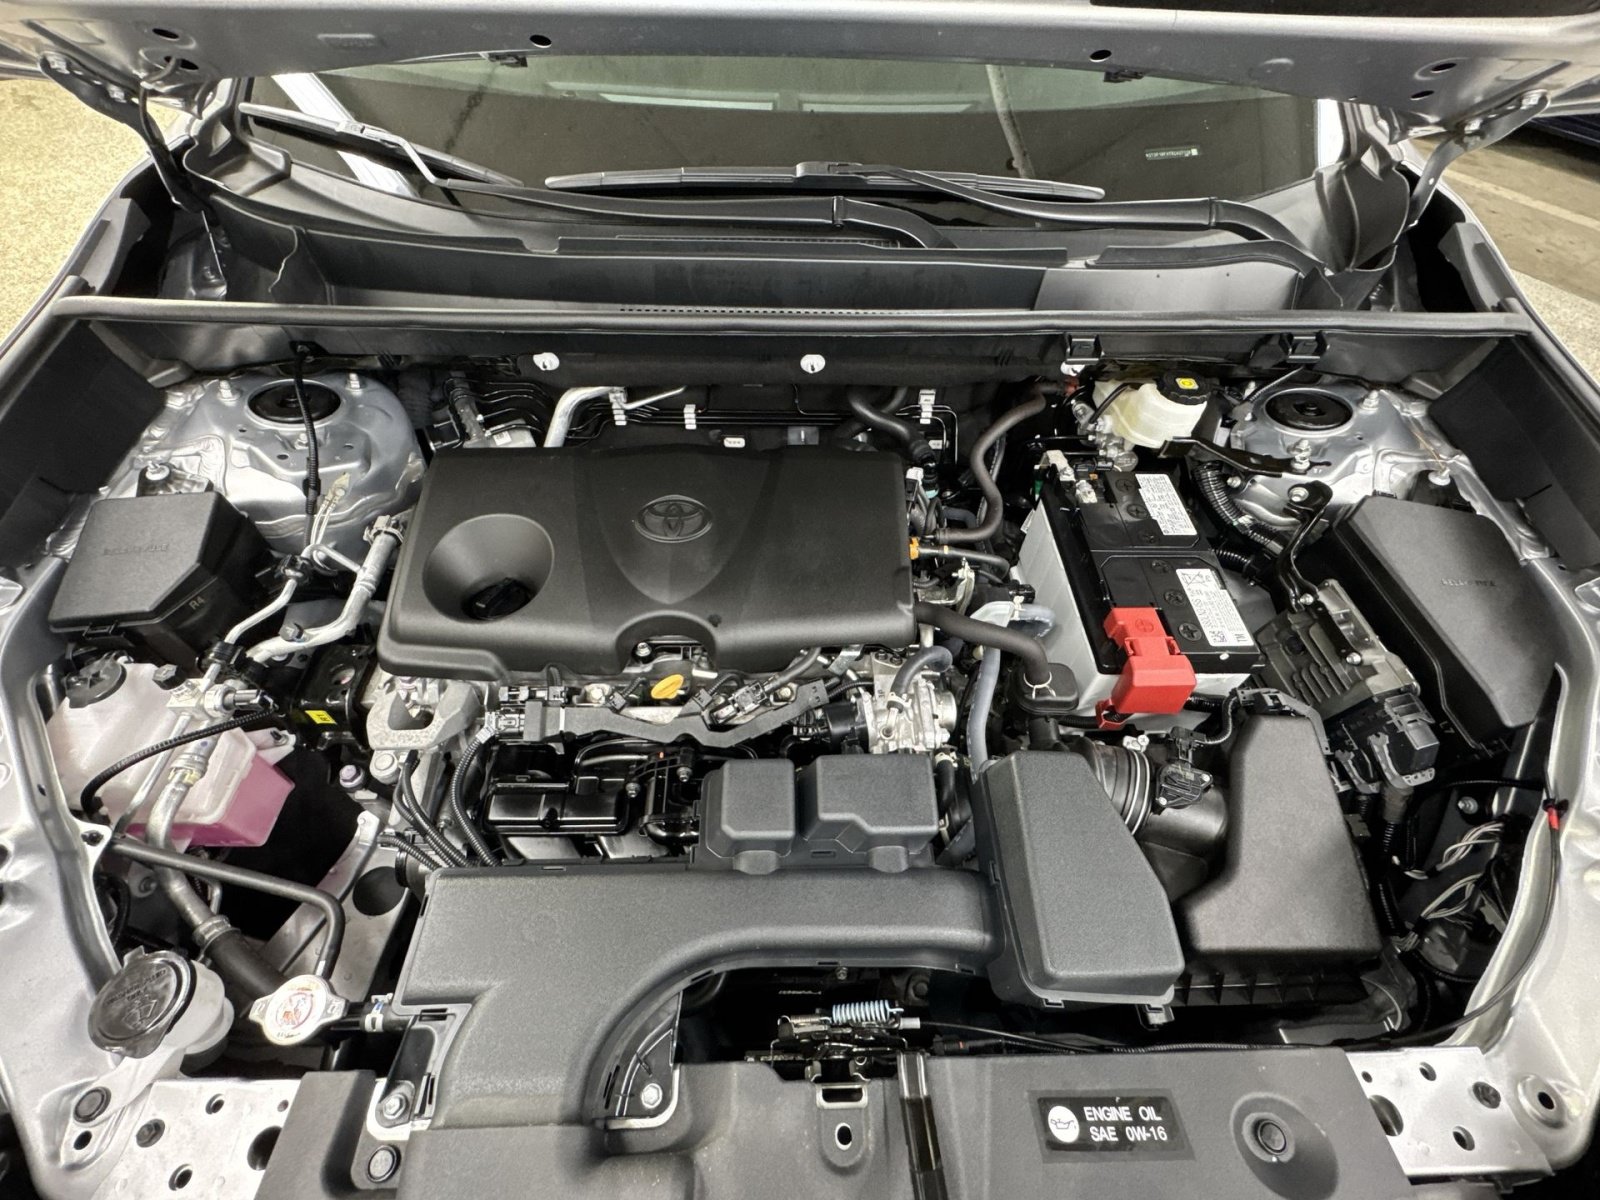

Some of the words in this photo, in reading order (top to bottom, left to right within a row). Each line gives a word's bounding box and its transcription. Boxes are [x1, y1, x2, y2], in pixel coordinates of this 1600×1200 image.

[188, 596, 205, 610] R4
[1083, 1105, 1133, 1121] ENGINE
[1138, 1105, 1163, 1121] OIL
[1089, 1125, 1119, 1142] SAE
[1125, 1125, 1169, 1142] 0W-16
